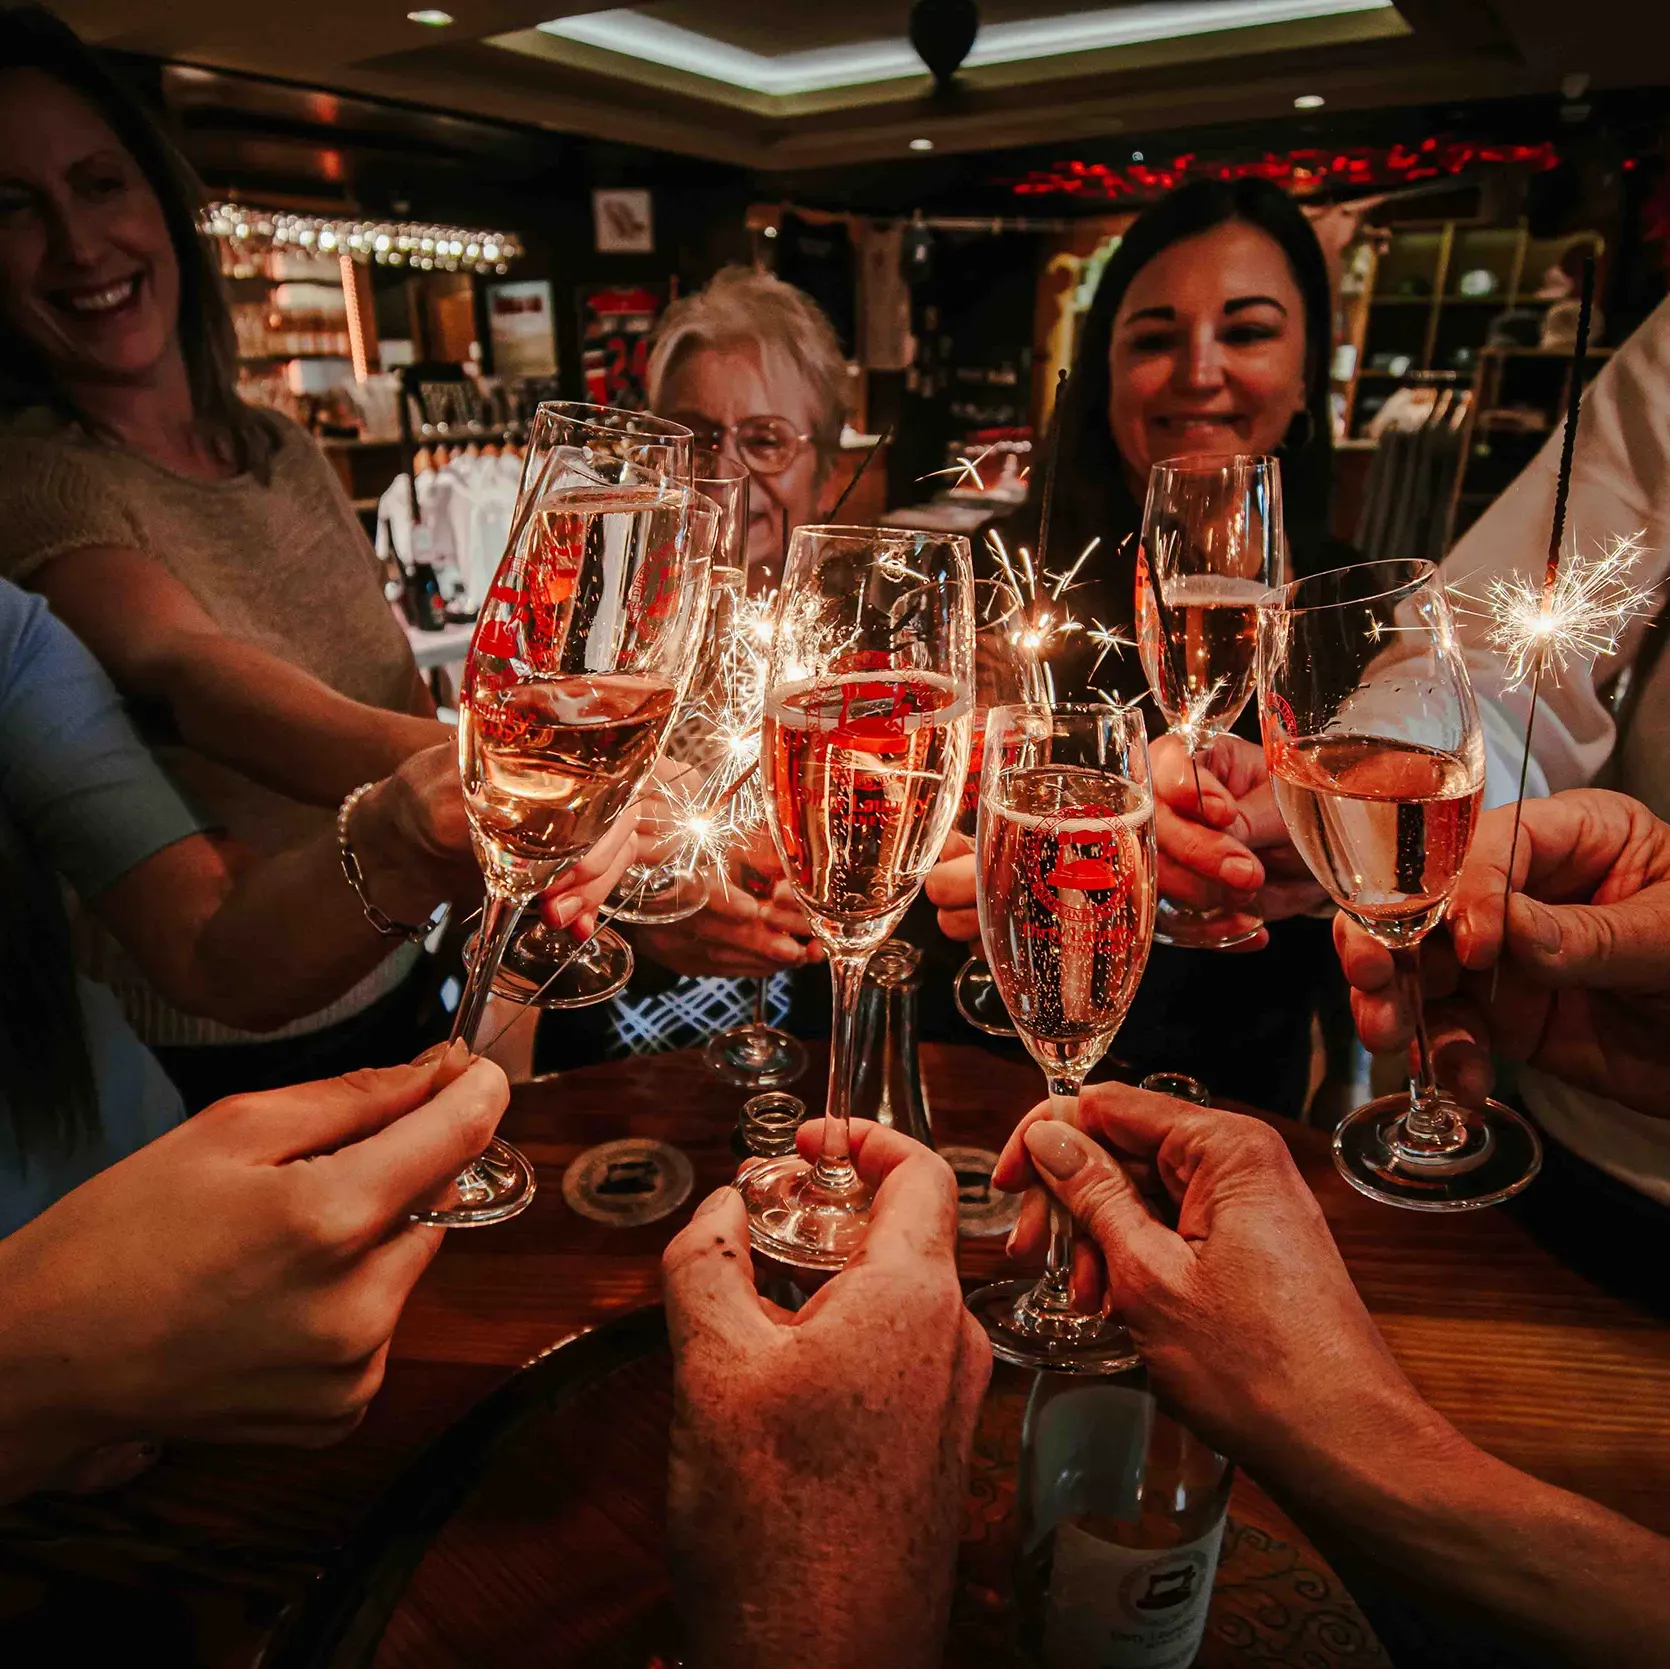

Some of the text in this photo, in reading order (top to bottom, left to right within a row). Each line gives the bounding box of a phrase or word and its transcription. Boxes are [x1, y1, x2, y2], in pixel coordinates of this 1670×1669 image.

[801, 787, 928, 816] Diry Launy
[1022, 922, 1062, 945] Dirty
